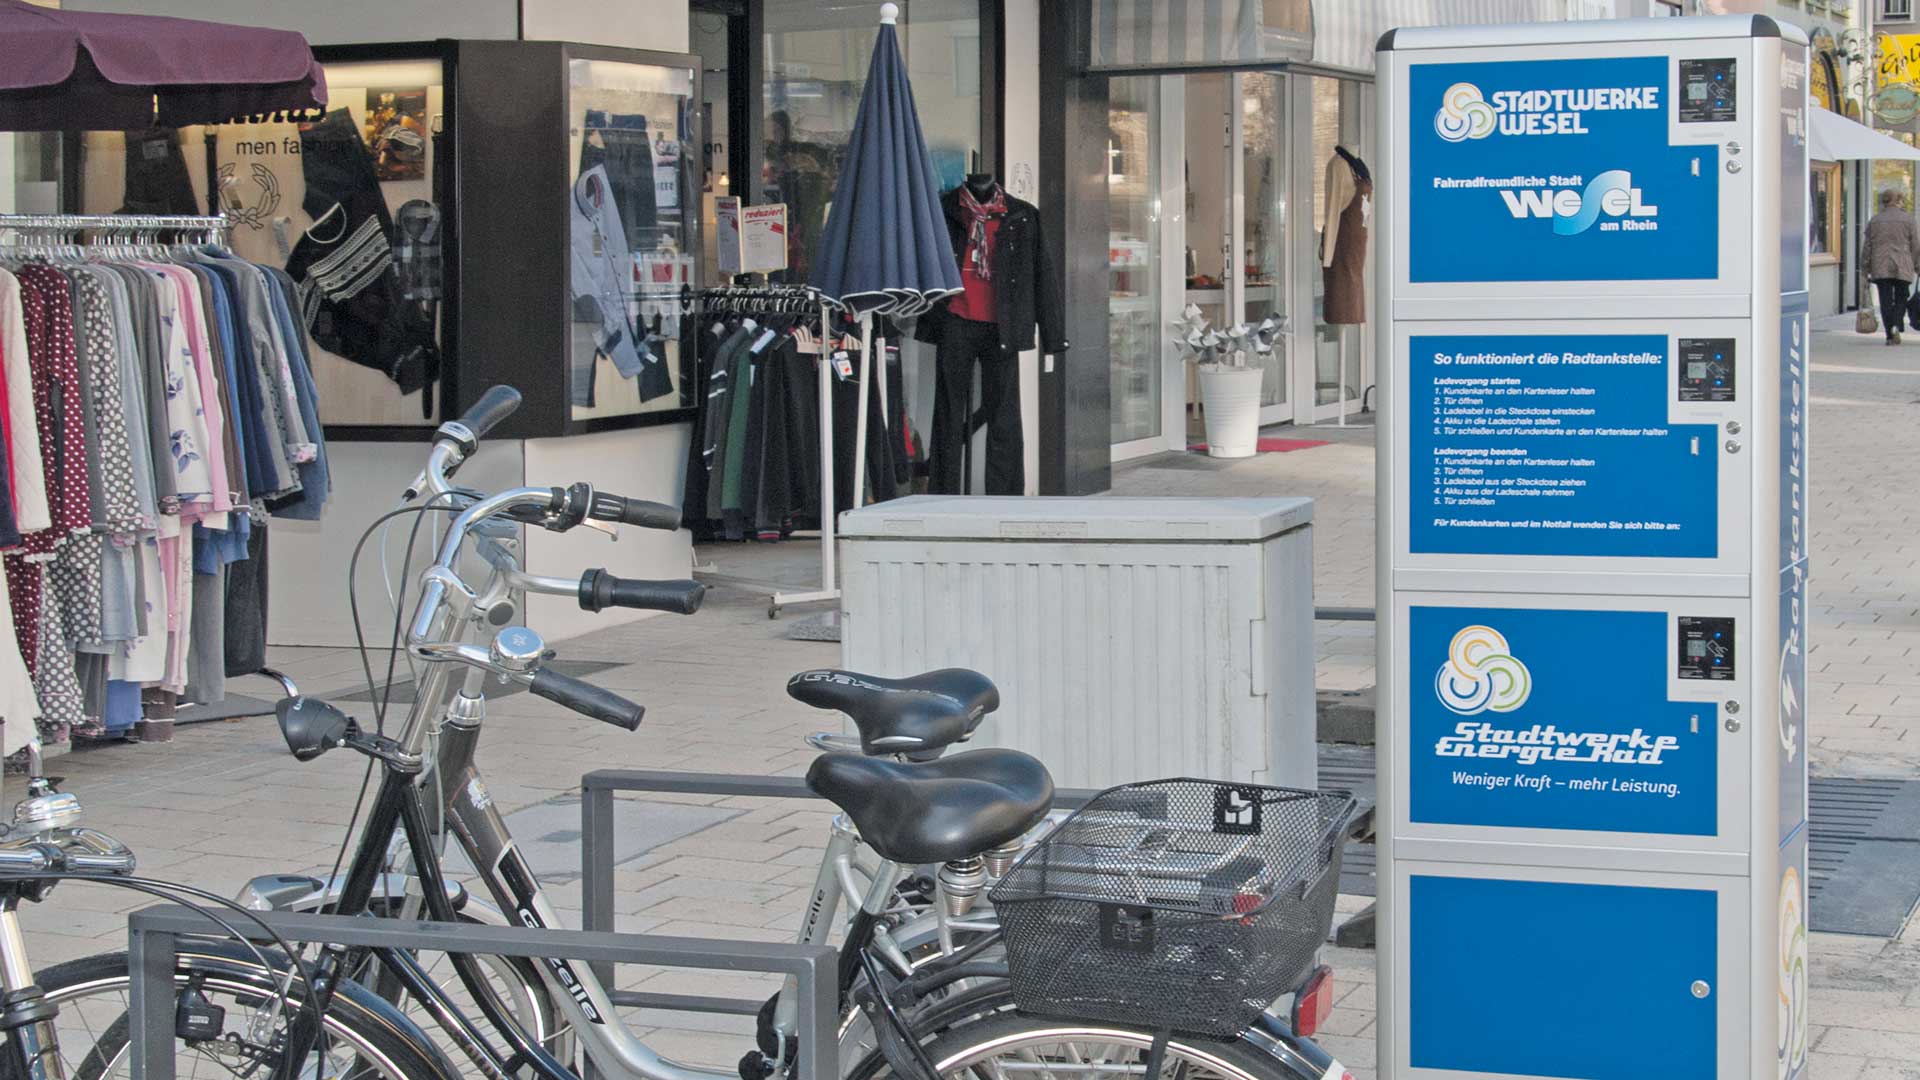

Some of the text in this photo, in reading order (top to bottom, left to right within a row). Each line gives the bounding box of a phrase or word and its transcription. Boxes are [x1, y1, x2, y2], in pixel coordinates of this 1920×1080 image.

[1492, 87, 1659, 112] STADTWERKE
[1500, 112, 1589, 136] WESEL
[236, 140, 276, 155] men
[1434, 175, 1583, 188] Fahrradfreundliche Stadt
[745, 207, 784, 219] reduziert
[1600, 219, 1658, 231] am Rhein
[1434, 353, 1662, 364] So funktioniert die Radtankstelle:
[1434, 377, 1489, 386] Ladevorgang
[1524, 387, 1569, 395] Kartenleser
[1570, 387, 1595, 395] halten
[1458, 396, 1483, 404] öffnen
[1509, 407, 1550, 415] Steckdose
[1552, 407, 1595, 415] einstecken
[1488, 417, 1533, 425] Ladeschale
[1535, 417, 1560, 425] stellen
[1458, 426, 1495, 435] schließen
[1514, 427, 1564, 435] Kundenkarte
[1595, 427, 1641, 435] Kartenleser
[1434, 447, 1527, 456] Ladevorgang beenden
[1444, 457, 1493, 465] Kundenkarte
[1570, 458, 1595, 466] halten
[1458, 467, 1483, 475] öffnen
[1444, 477, 1483, 485] Ladekabel
[1516, 477, 1558, 486] Steckdose
[1560, 478, 1586, 486] ziehen
[1444, 487, 1463, 495] Akku
[1496, 488, 1541, 496] Ladeschale
[1542, 488, 1575, 496] nehmen
[1458, 497, 1495, 505] schließen
[1450, 518, 1510, 527] Kundenkarten
[1542, 520, 1572, 528] Notfall
[1573, 520, 1607, 528] wenden
[1624, 521, 1642, 529] sich
[1644, 521, 1665, 529] bitte
[1453, 721, 1680, 750] Stadtwerke
[1452, 771, 1511, 790] Weniger
[1514, 774, 1551, 792] Kraft
[1569, 778, 1608, 791] mehr
[1611, 778, 1681, 798] Leistung.
